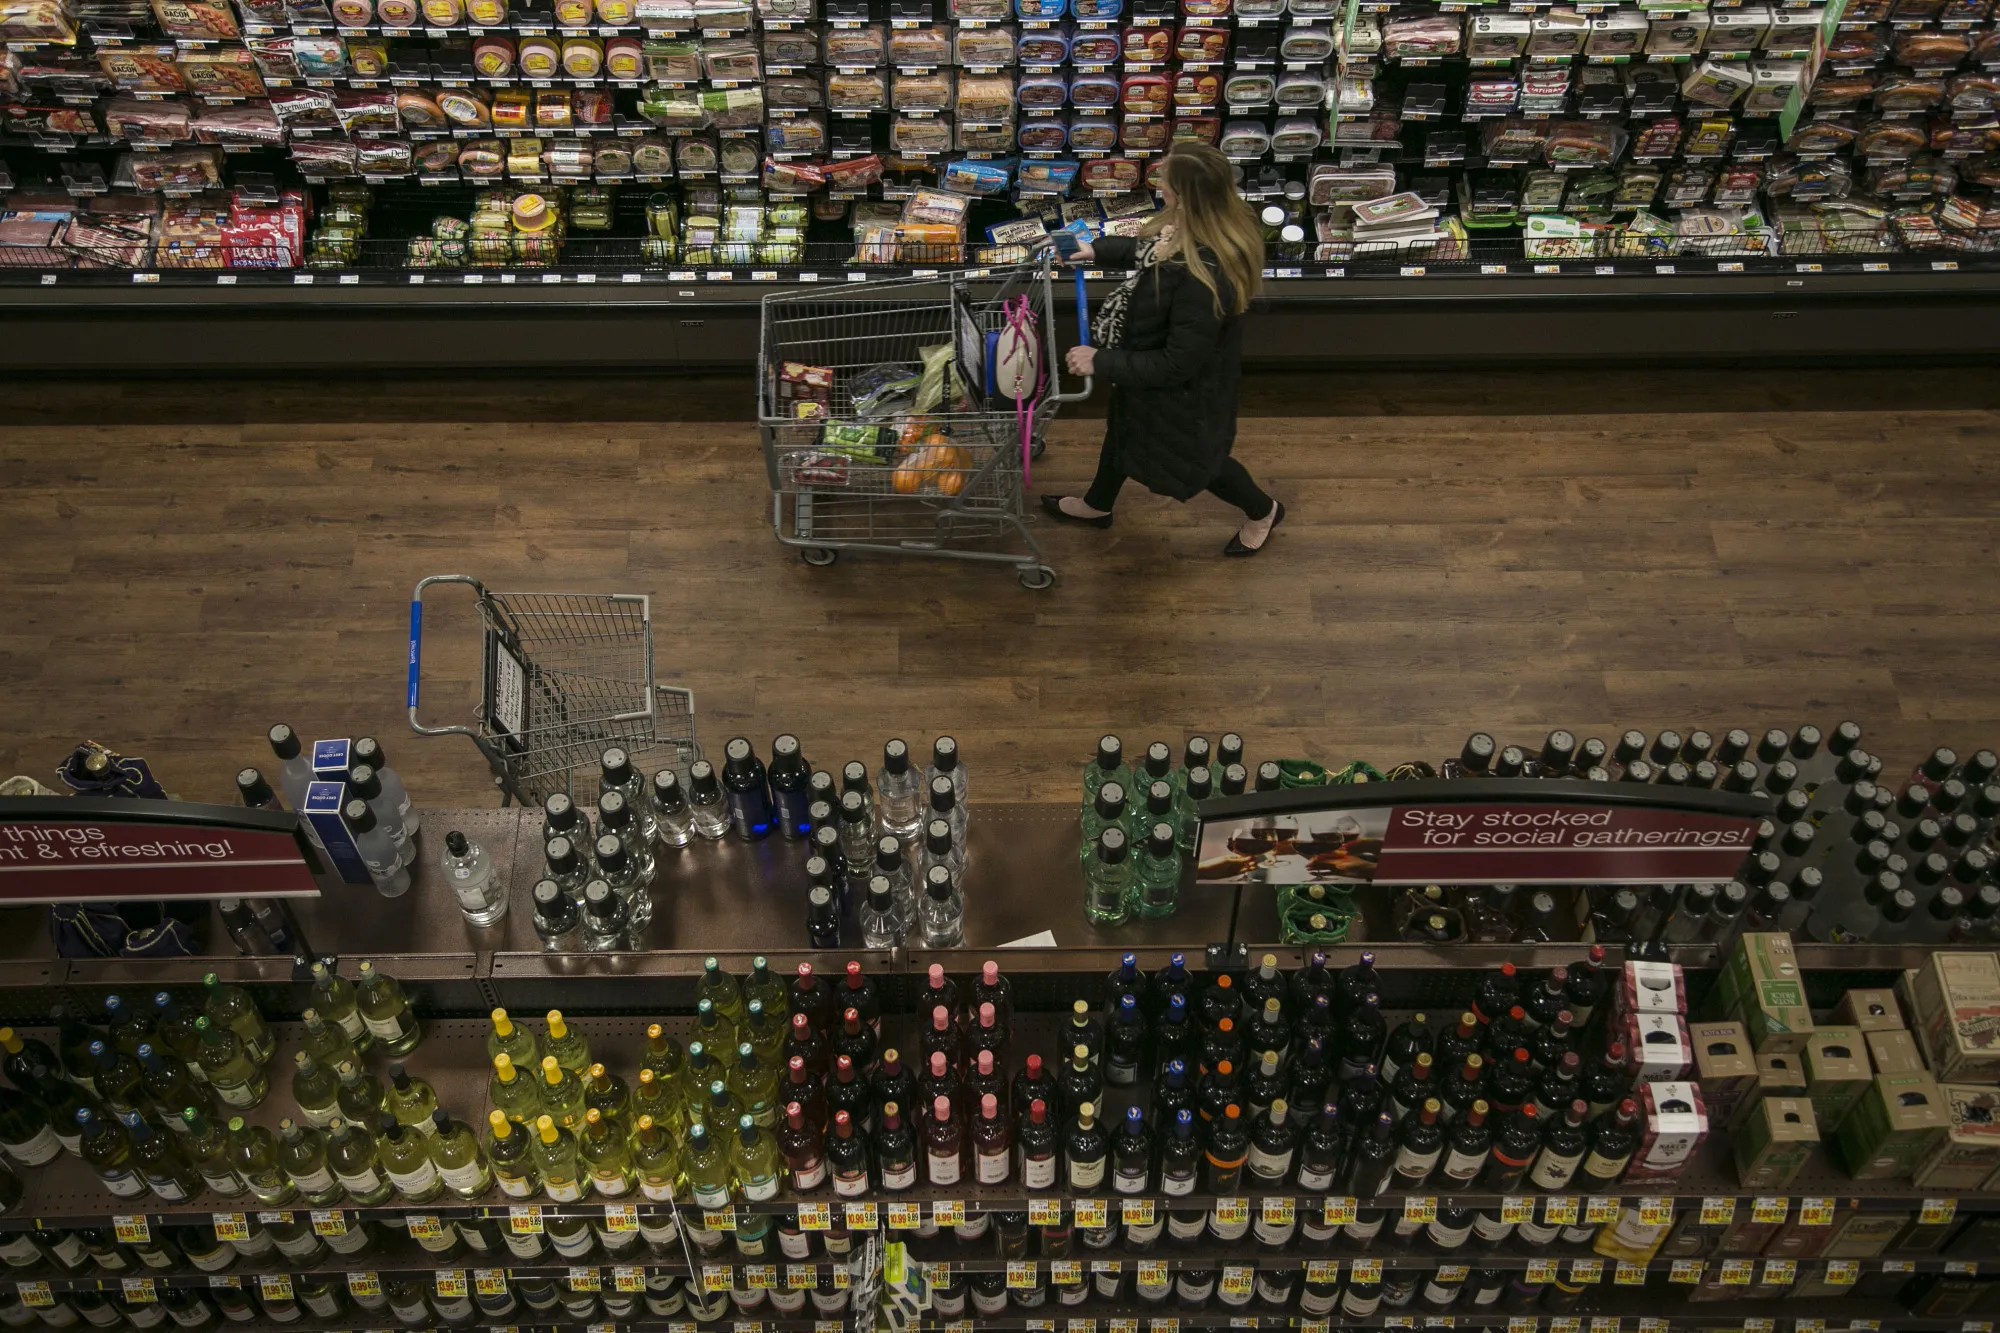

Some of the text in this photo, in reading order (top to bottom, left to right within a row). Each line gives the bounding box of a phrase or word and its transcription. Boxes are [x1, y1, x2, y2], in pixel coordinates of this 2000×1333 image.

[164, 10, 190, 18] BACON
[1402, 810, 1612, 830] Stay stocked
[3, 825, 106, 844] things
[1423, 827, 1751, 847] for social gatherings!
[36, 843, 64, 859] &
[69, 839, 235, 858] refreshing!
[934, 1212, 964, 1222] 8.99 8.09
[1030, 1211, 1059, 1222] 8.99 8.09
[1076, 1211, 1105, 1222] 12.49 11.24
[1124, 1209, 1153, 1220] 10.99 9.89
[1218, 1208, 1248, 1218] 10.99 9.89
[1264, 1210, 1281, 1219] 9.99
[1326, 1208, 1343, 1218] 10.99
[1406, 1209, 1423, 1218] 9.99
[1504, 1209, 1520, 1218] 10.99
[1640, 1209, 1658, 1219] 15.99
[512, 1216, 541, 1228] 10.99 9.89
[608, 1215, 637, 1226] 10.99 9.89
[704, 1214, 734, 1226] 10.99 9.89
[800, 1214, 829, 1224] 10.99 9.89
[848, 1213, 876, 1224] 10.99 9.89
[890, 1213, 918, 1224] 10.99 9.89
[116, 1225, 147, 1237] 10.99 9.89
[216, 1223, 246, 1234] 10.99 9.89
[315, 1221, 332, 1231] 11.99
[411, 1226, 428, 1234] 9.99
[836, 1274, 849, 1284] 10.9
[937, 1274, 948, 1282] 8.99
[1008, 1272, 1035, 1282] 10.99 9.89
[1054, 1272, 1070, 1280] 10.99
[1140, 1271, 1154, 1280] 11.99
[1354, 1270, 1369, 1278] 11.99
[616, 1278, 634, 1287] 11.99
[704, 1277, 721, 1286] 10.49
[748, 1275, 764, 1284] 10.99
[789, 1275, 805, 1284] 8.99
[1224, 1278, 1240, 1288] 9.99
[263, 1285, 280, 1294] 11.99
[350, 1282, 368, 1292] 9.99
[437, 1281, 454, 1290] 13.99
[476, 1280, 494, 1290] 12.49
